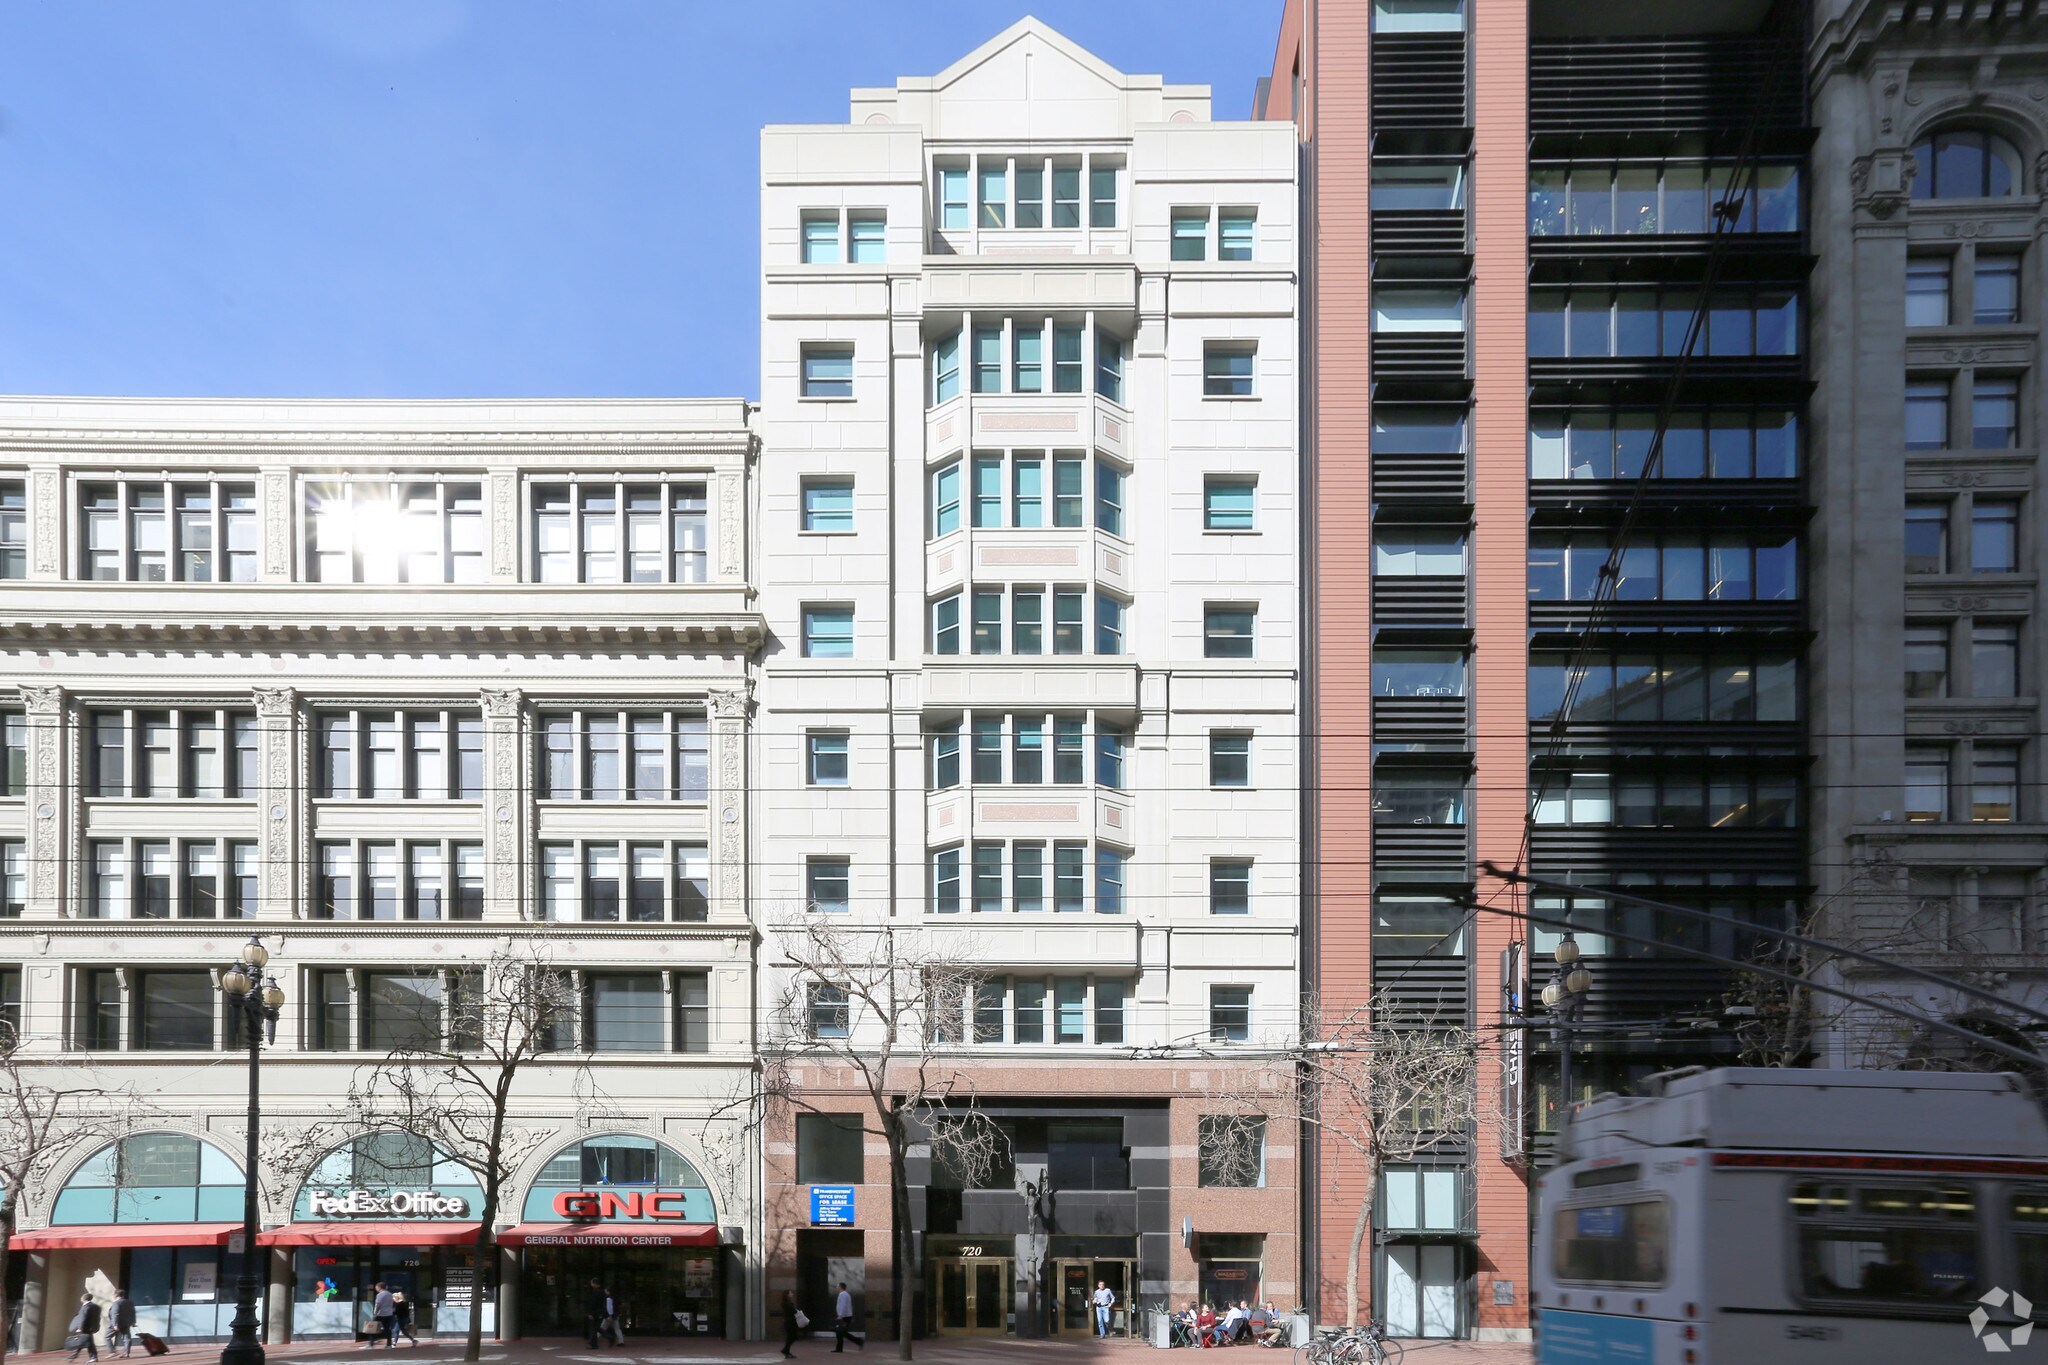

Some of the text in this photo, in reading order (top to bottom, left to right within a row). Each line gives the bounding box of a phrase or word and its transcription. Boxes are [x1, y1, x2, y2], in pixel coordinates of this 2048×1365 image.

[310, 1190, 464, 1213] FedEx Office
[553, 1191, 685, 1218] GNC
[525, 1236, 672, 1245] GENERAL NUTRITION CENTER
[962, 1246, 982, 1256] 720
[316, 1257, 337, 1265] OPEN
